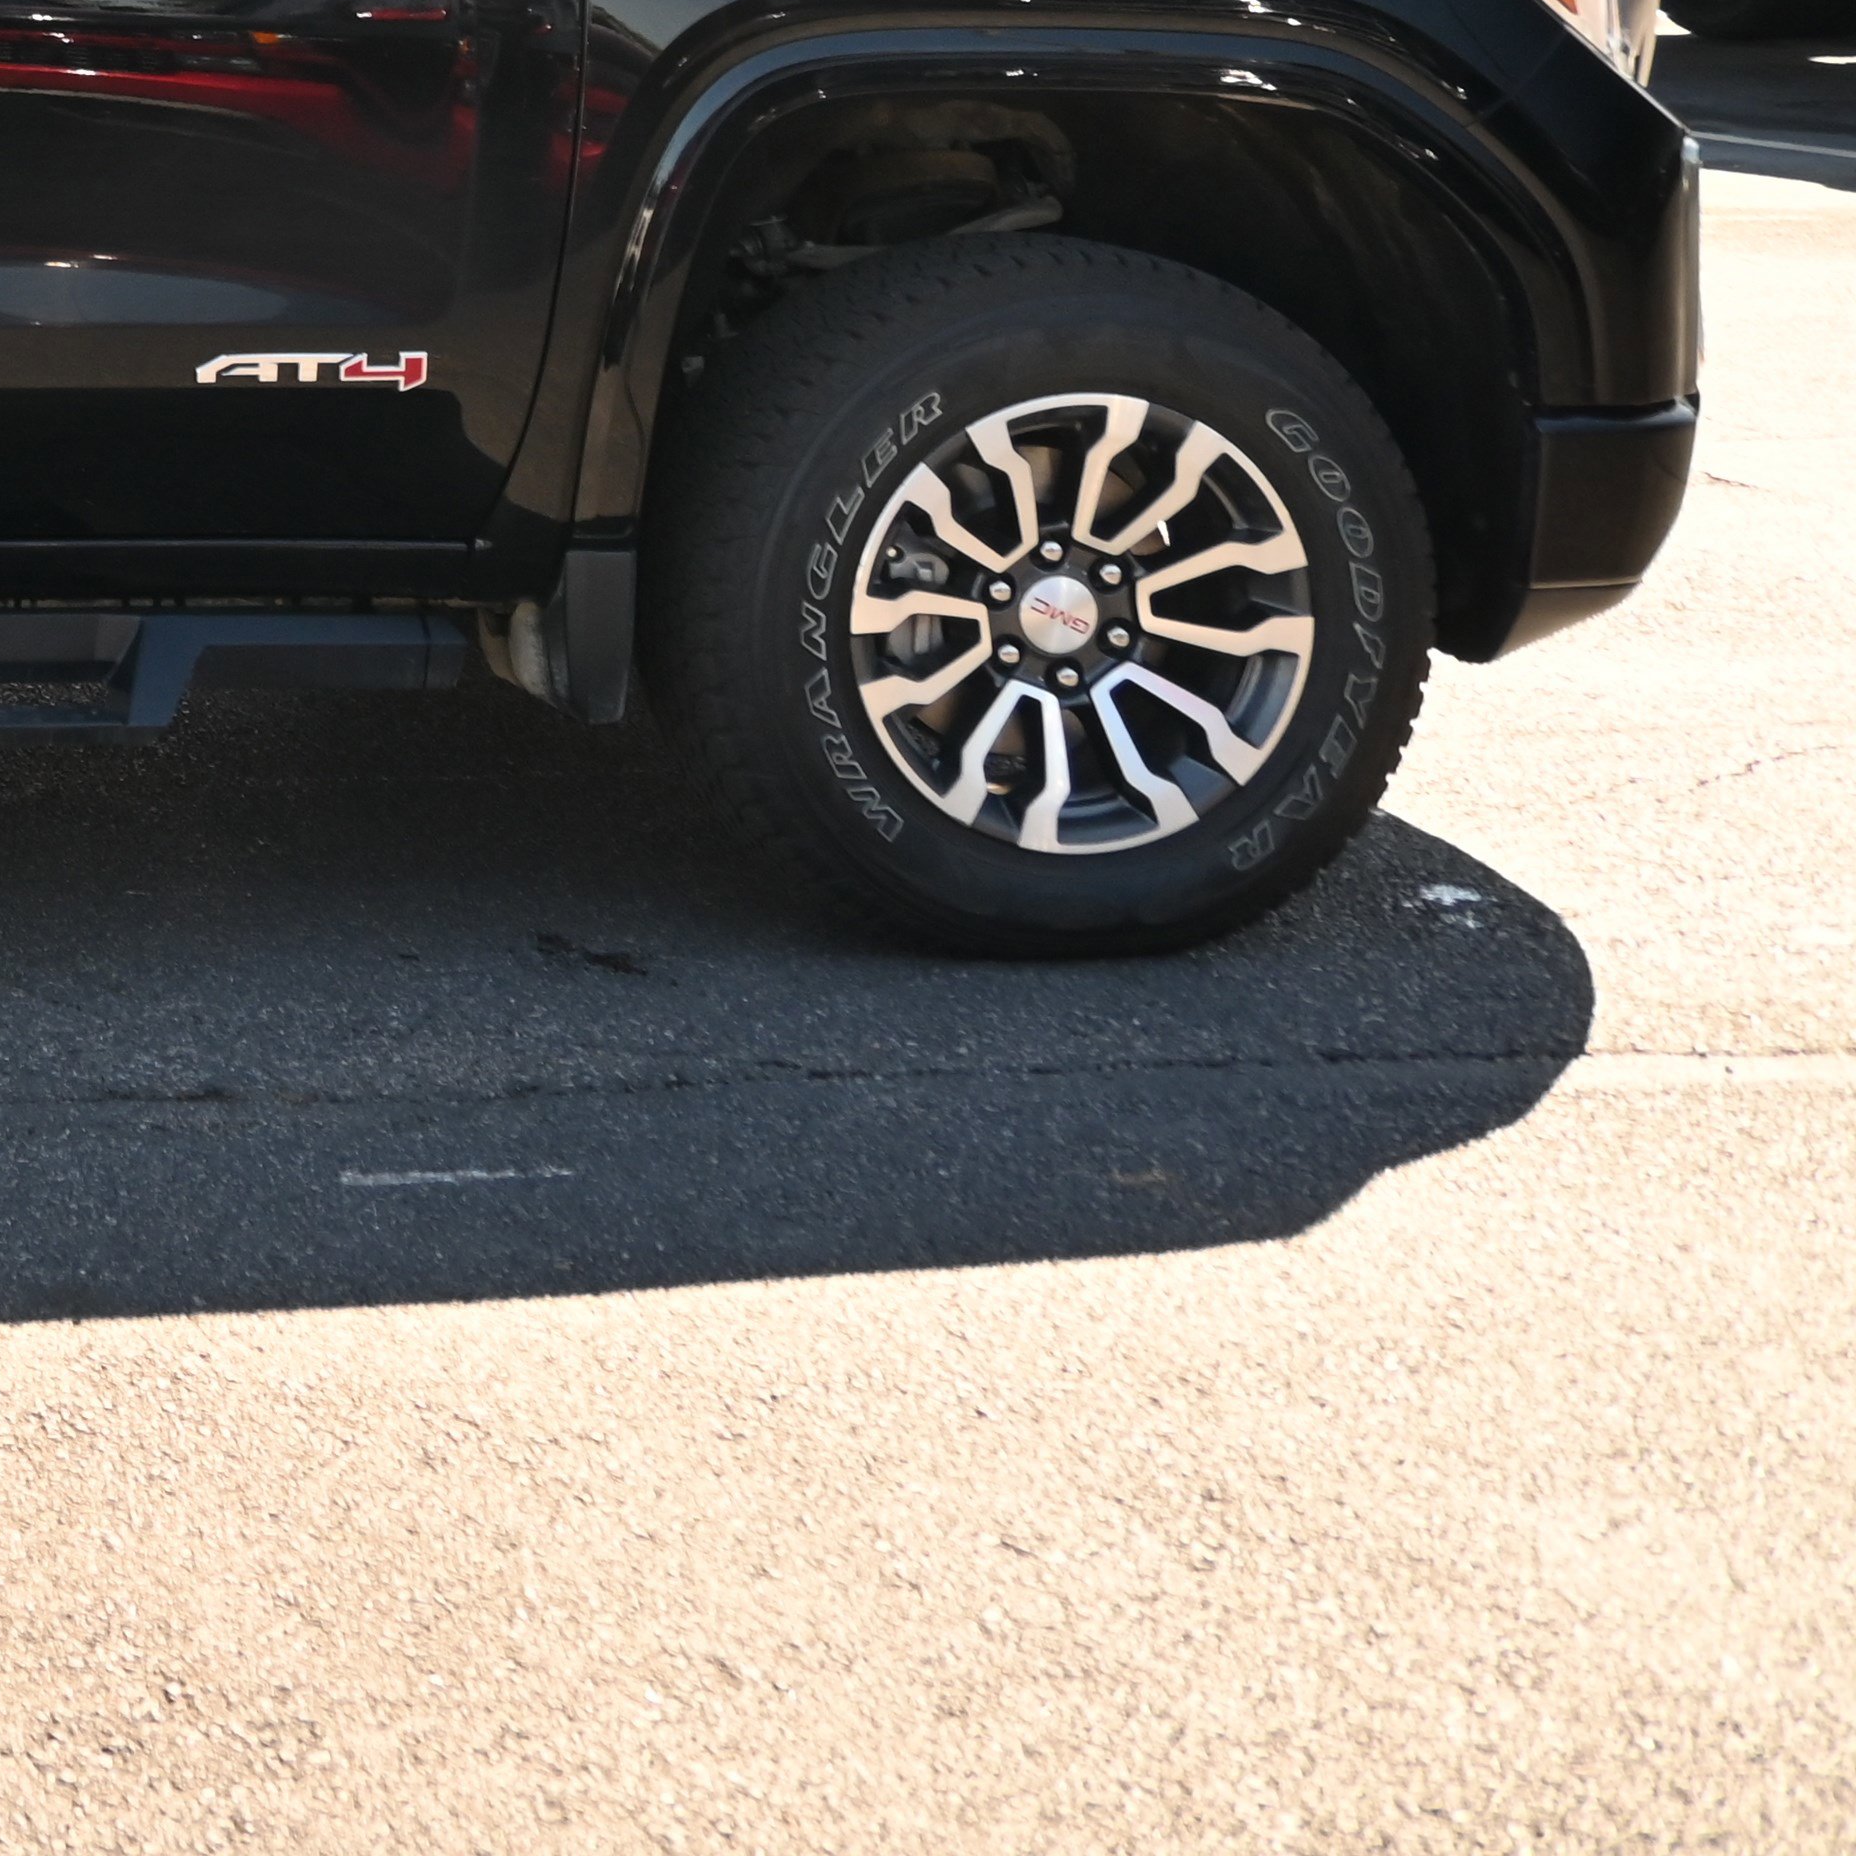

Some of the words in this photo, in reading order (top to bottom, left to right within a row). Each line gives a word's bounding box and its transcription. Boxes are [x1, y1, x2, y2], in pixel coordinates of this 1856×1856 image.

[195, 351, 428, 392] AT4
[798, 390, 943, 844] WRANGLER
[1031, 597, 1090, 634] GMC
